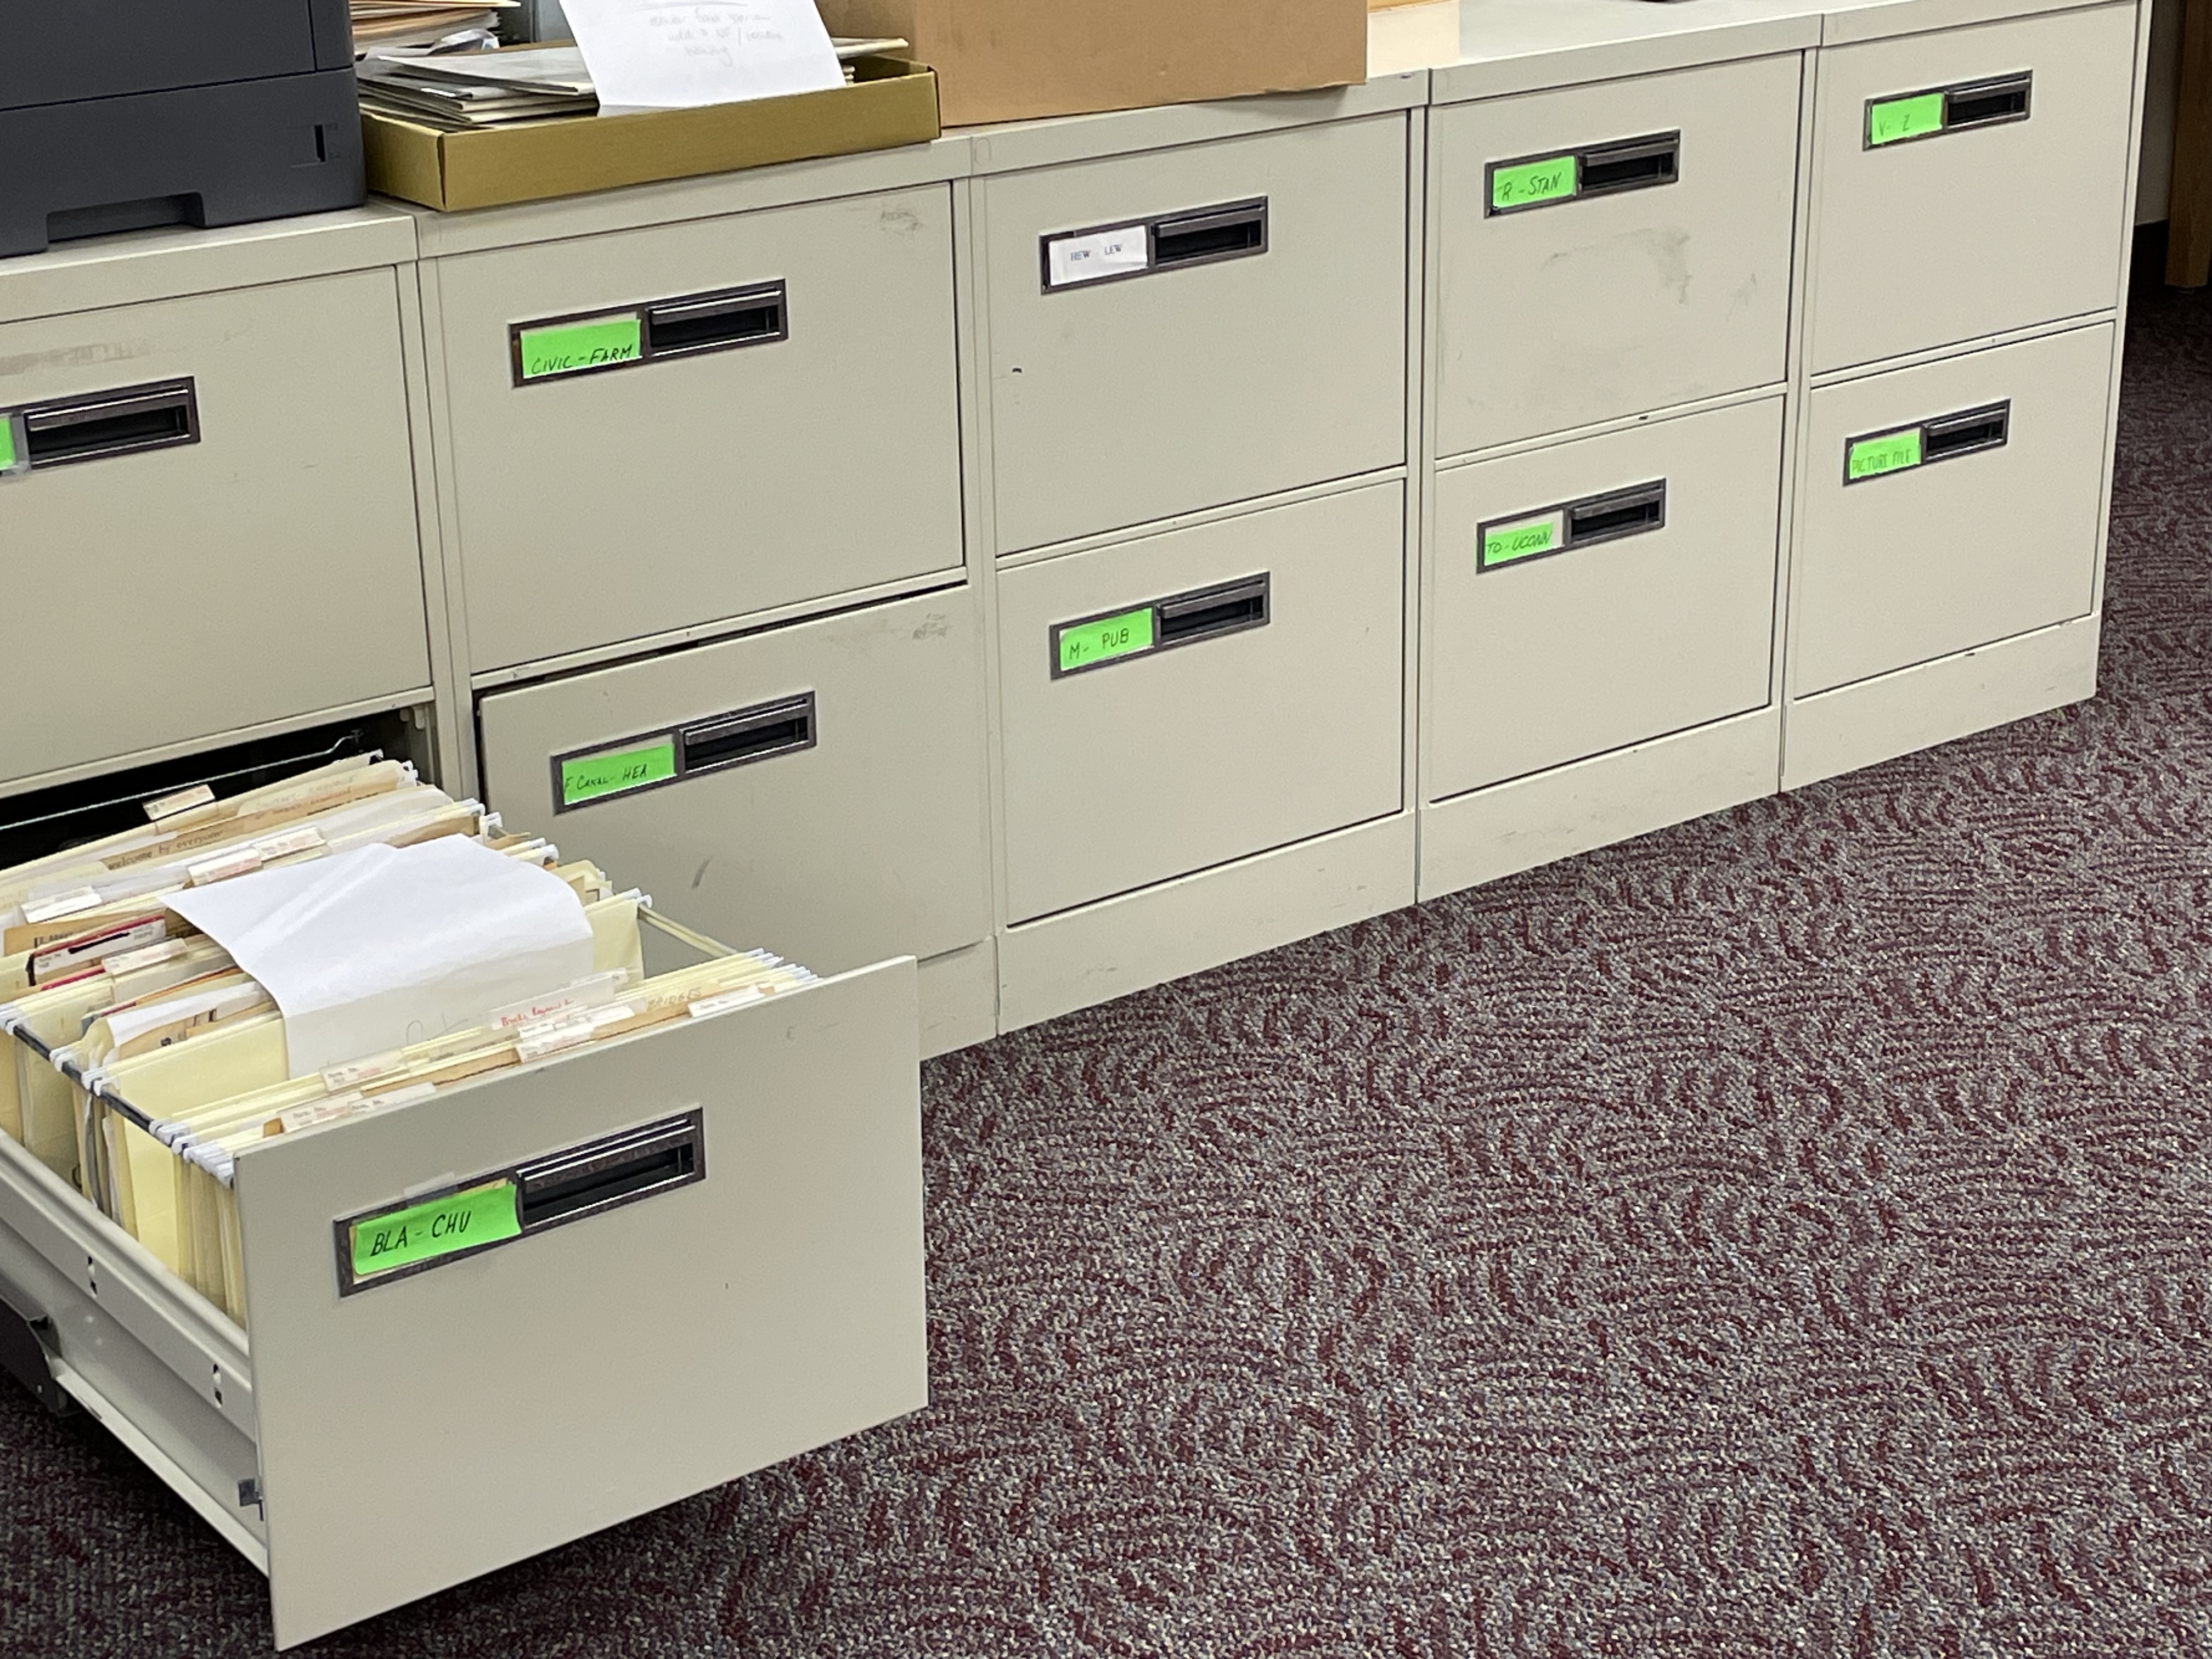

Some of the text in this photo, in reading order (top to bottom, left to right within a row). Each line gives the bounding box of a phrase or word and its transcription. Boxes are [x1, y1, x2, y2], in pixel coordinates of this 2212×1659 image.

[1528, 172, 1562, 195] STAN
[1102, 627, 1129, 650] PUB
[370, 1225, 409, 1257] BLA
[431, 1210, 472, 1238] CHU
